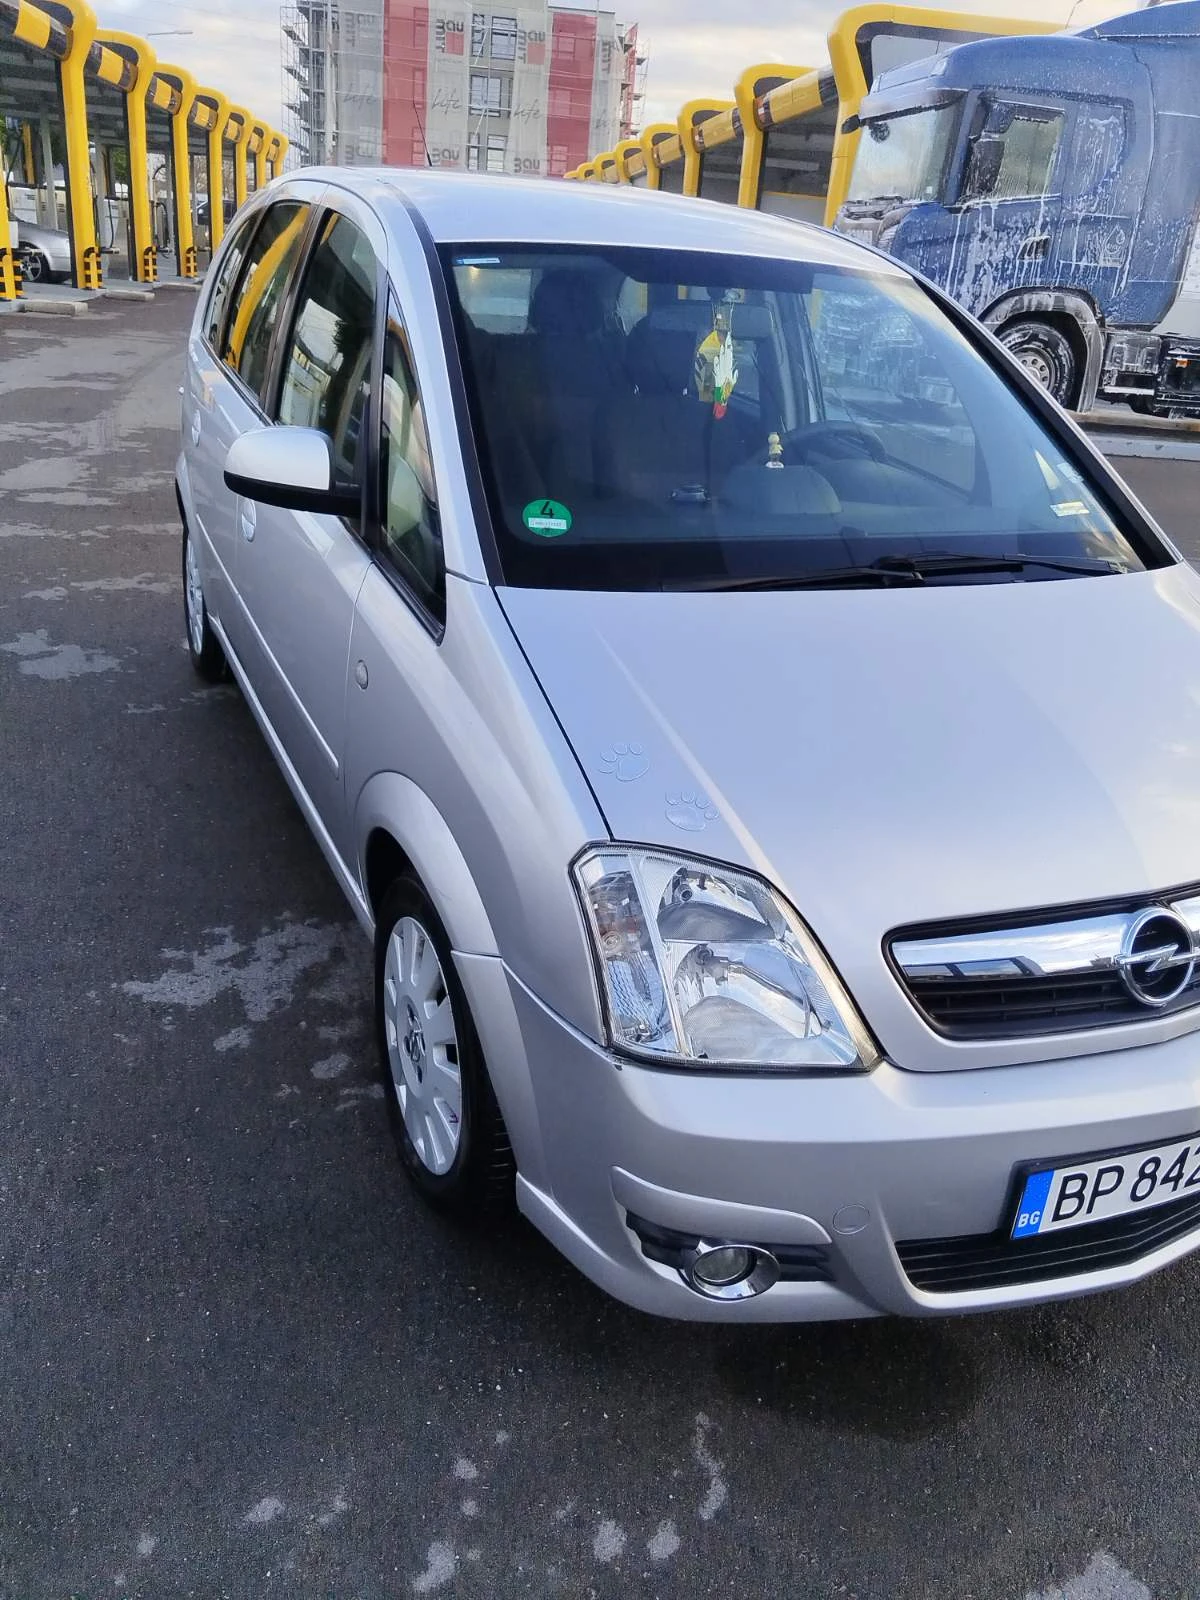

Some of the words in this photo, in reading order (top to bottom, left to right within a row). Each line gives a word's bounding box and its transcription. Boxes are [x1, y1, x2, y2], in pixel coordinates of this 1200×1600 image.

[541, 501, 555, 519] 4
[1051, 1165, 1124, 1222] BP
[1018, 1211, 1040, 1228] BG
